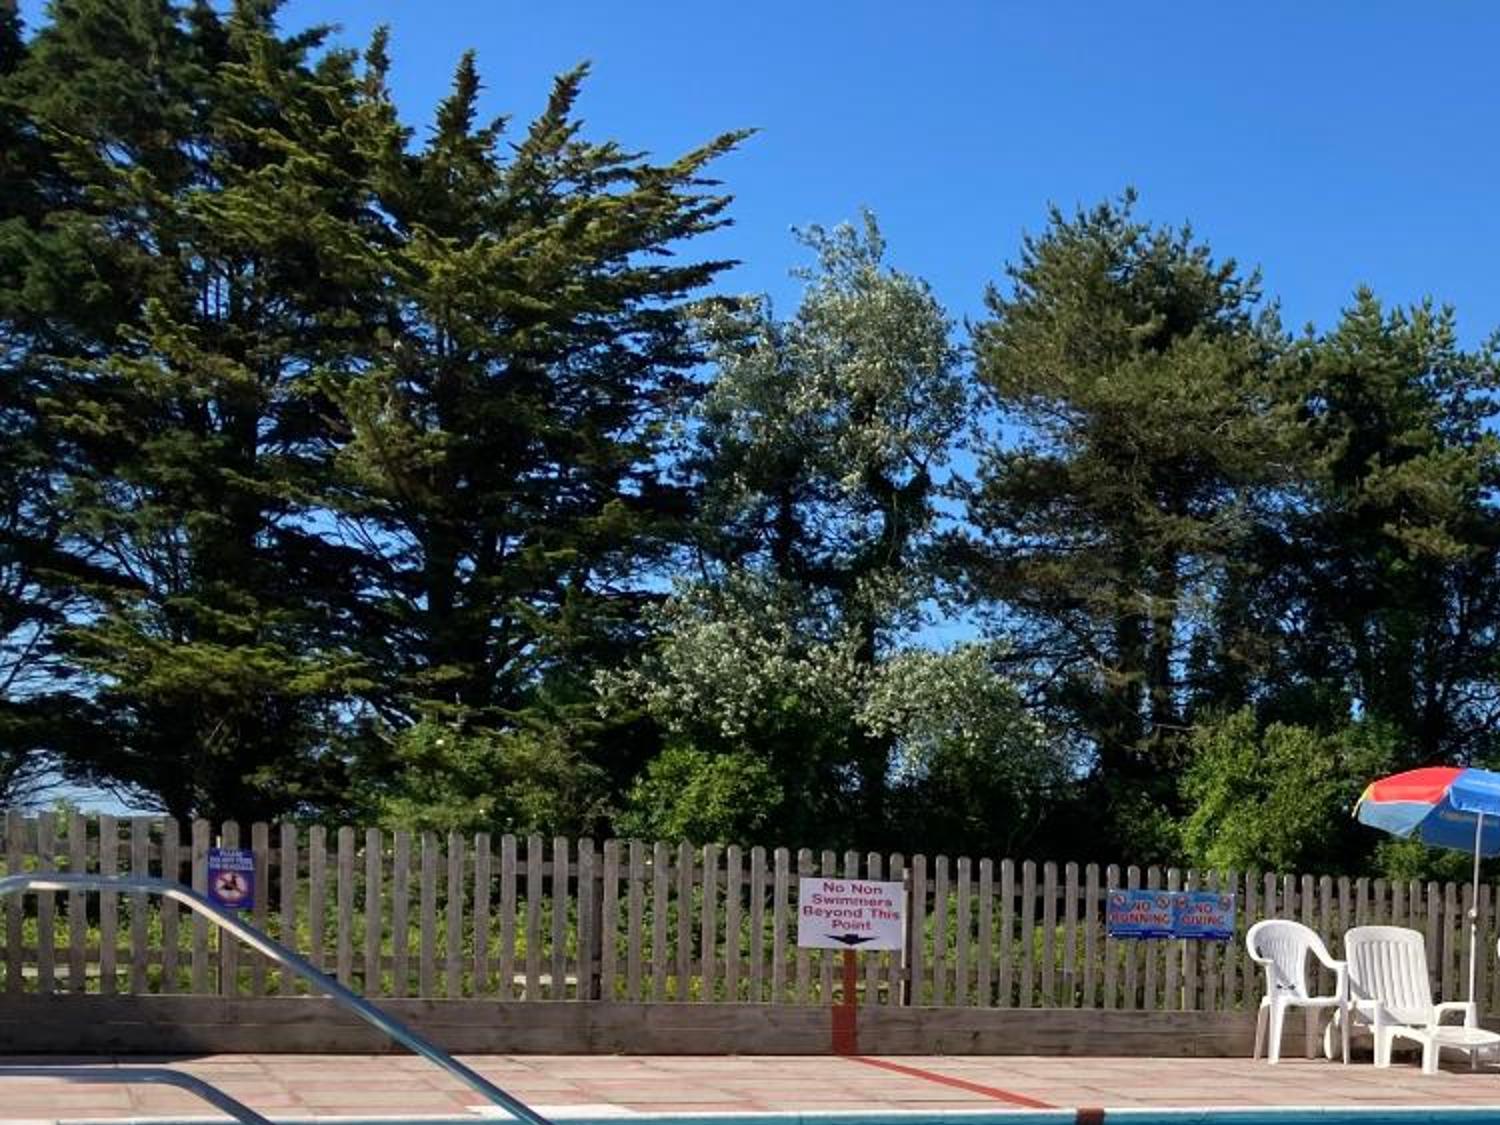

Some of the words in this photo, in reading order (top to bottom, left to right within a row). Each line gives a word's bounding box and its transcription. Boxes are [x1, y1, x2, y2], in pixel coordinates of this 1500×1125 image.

[823, 882, 845, 893] No
[851, 883, 883, 895] Non
[811, 893, 893, 907] Swimmers
[803, 905, 863, 919] Beyond
[871, 908, 900, 920] This
[1195, 903, 1213, 914] NO
[831, 919, 872, 931] Point
